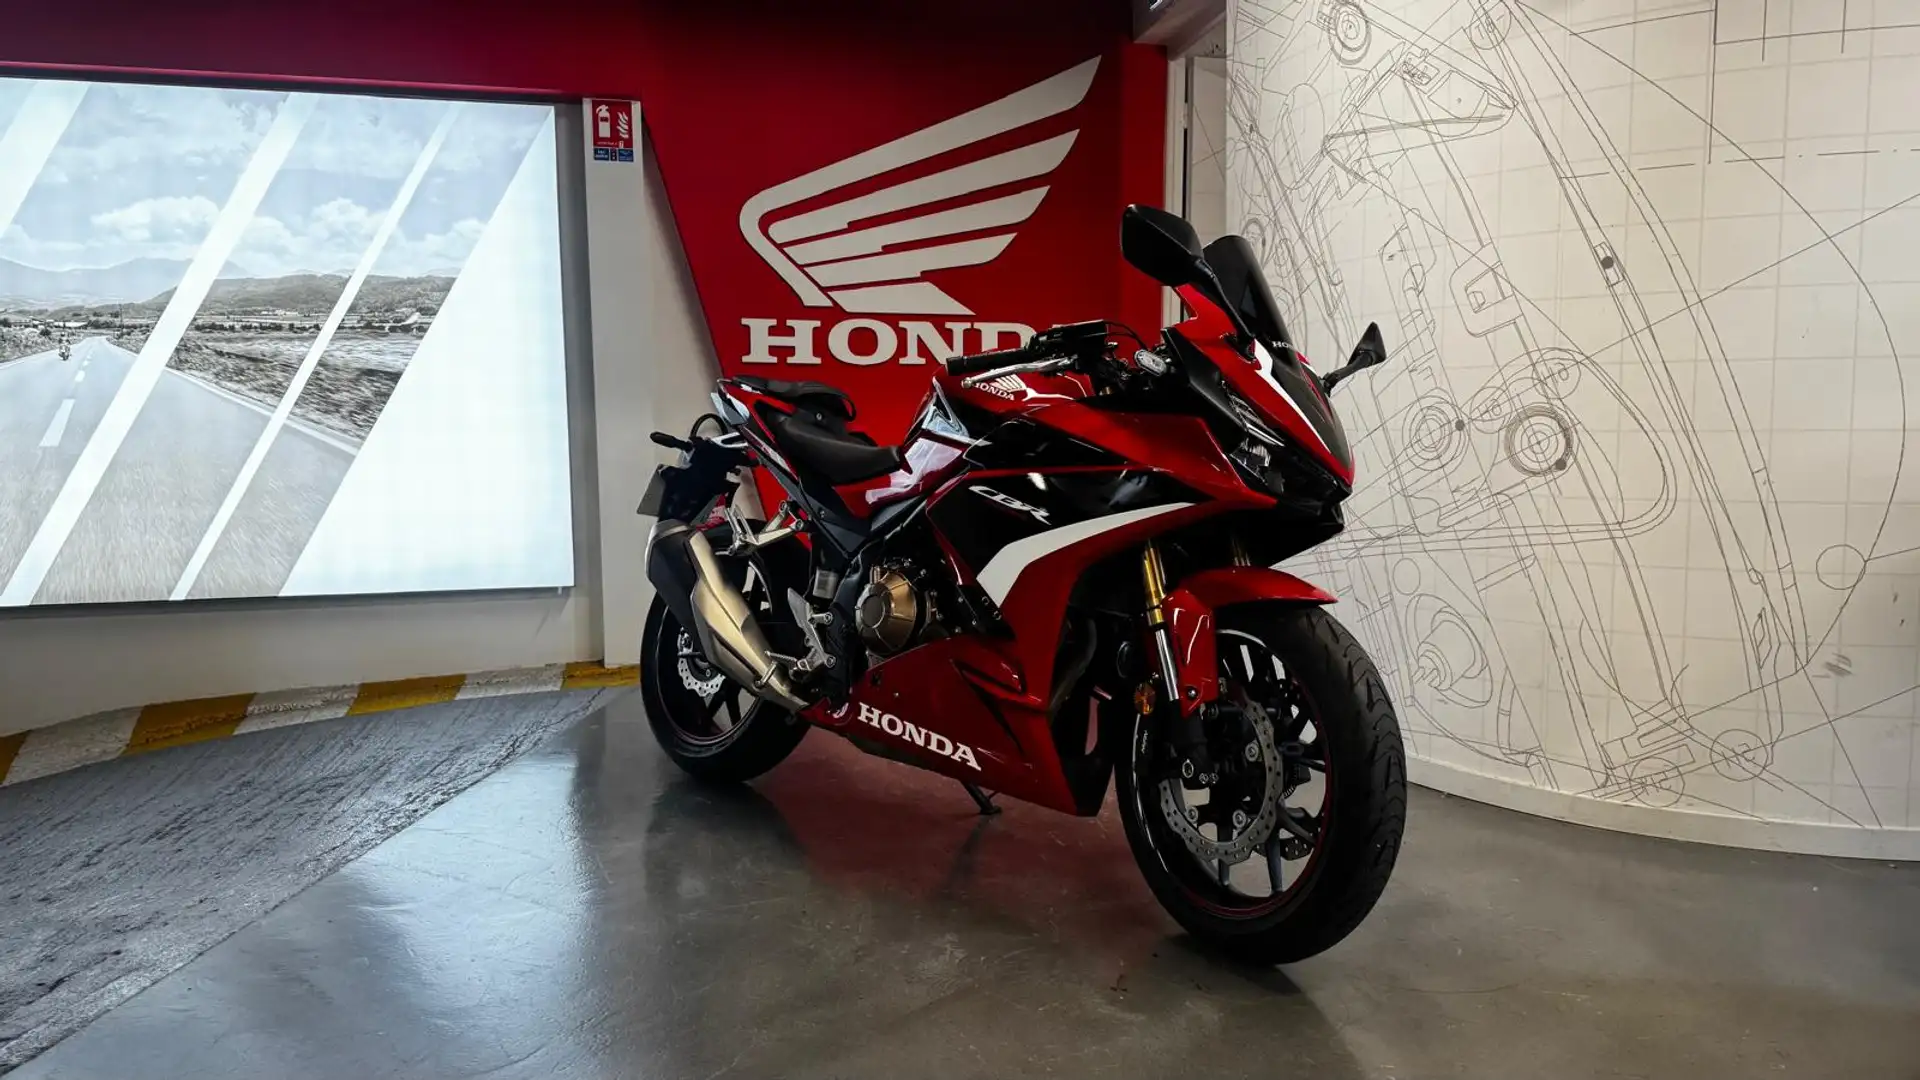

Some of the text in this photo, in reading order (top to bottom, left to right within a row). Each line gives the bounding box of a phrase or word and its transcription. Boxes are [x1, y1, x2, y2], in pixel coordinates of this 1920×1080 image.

[741, 317, 1050, 366] HOND
[968, 485, 1052, 526] CBR
[857, 701, 982, 772] HONDA
